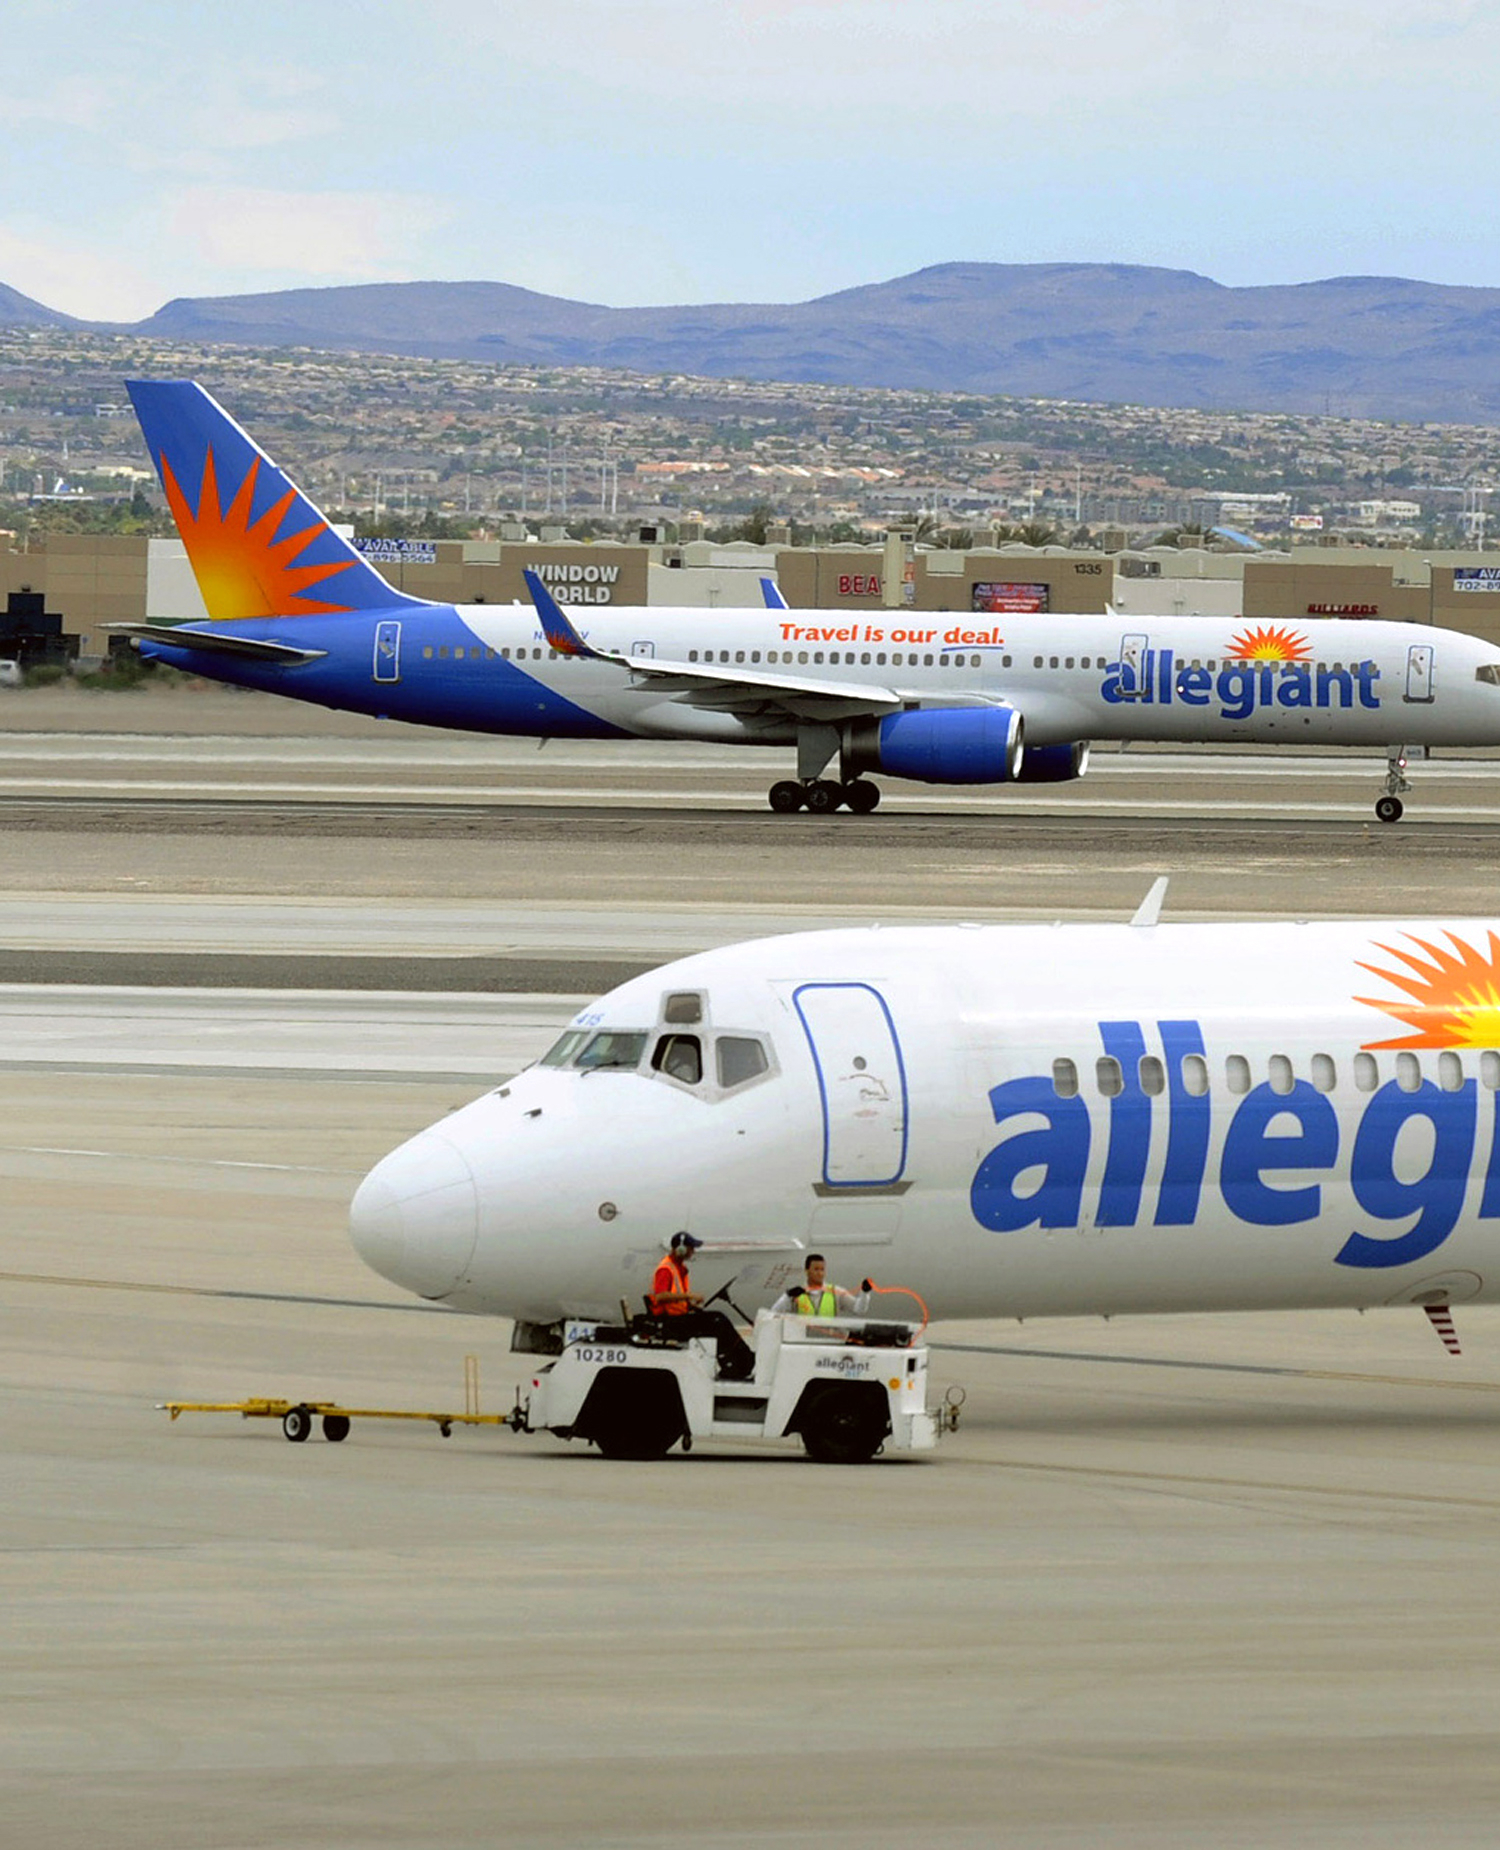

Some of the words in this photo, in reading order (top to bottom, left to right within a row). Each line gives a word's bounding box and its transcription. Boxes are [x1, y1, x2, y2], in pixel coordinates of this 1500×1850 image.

[363, 539, 436, 553] AVAILABLE
[526, 564, 619, 583] WINDOW
[1074, 563, 1103, 575] 1335
[837, 575, 882, 594] BEA
[547, 585, 611, 604] ORLD
[779, 623, 858, 641] Travel
[864, 625, 884, 642] is
[890, 628, 937, 643] our
[943, 627, 1004, 644] deal.
[1101, 649, 1381, 719] allegiant
[575, 1349, 627, 1363] 10280
[815, 1357, 870, 1372] allegiant
